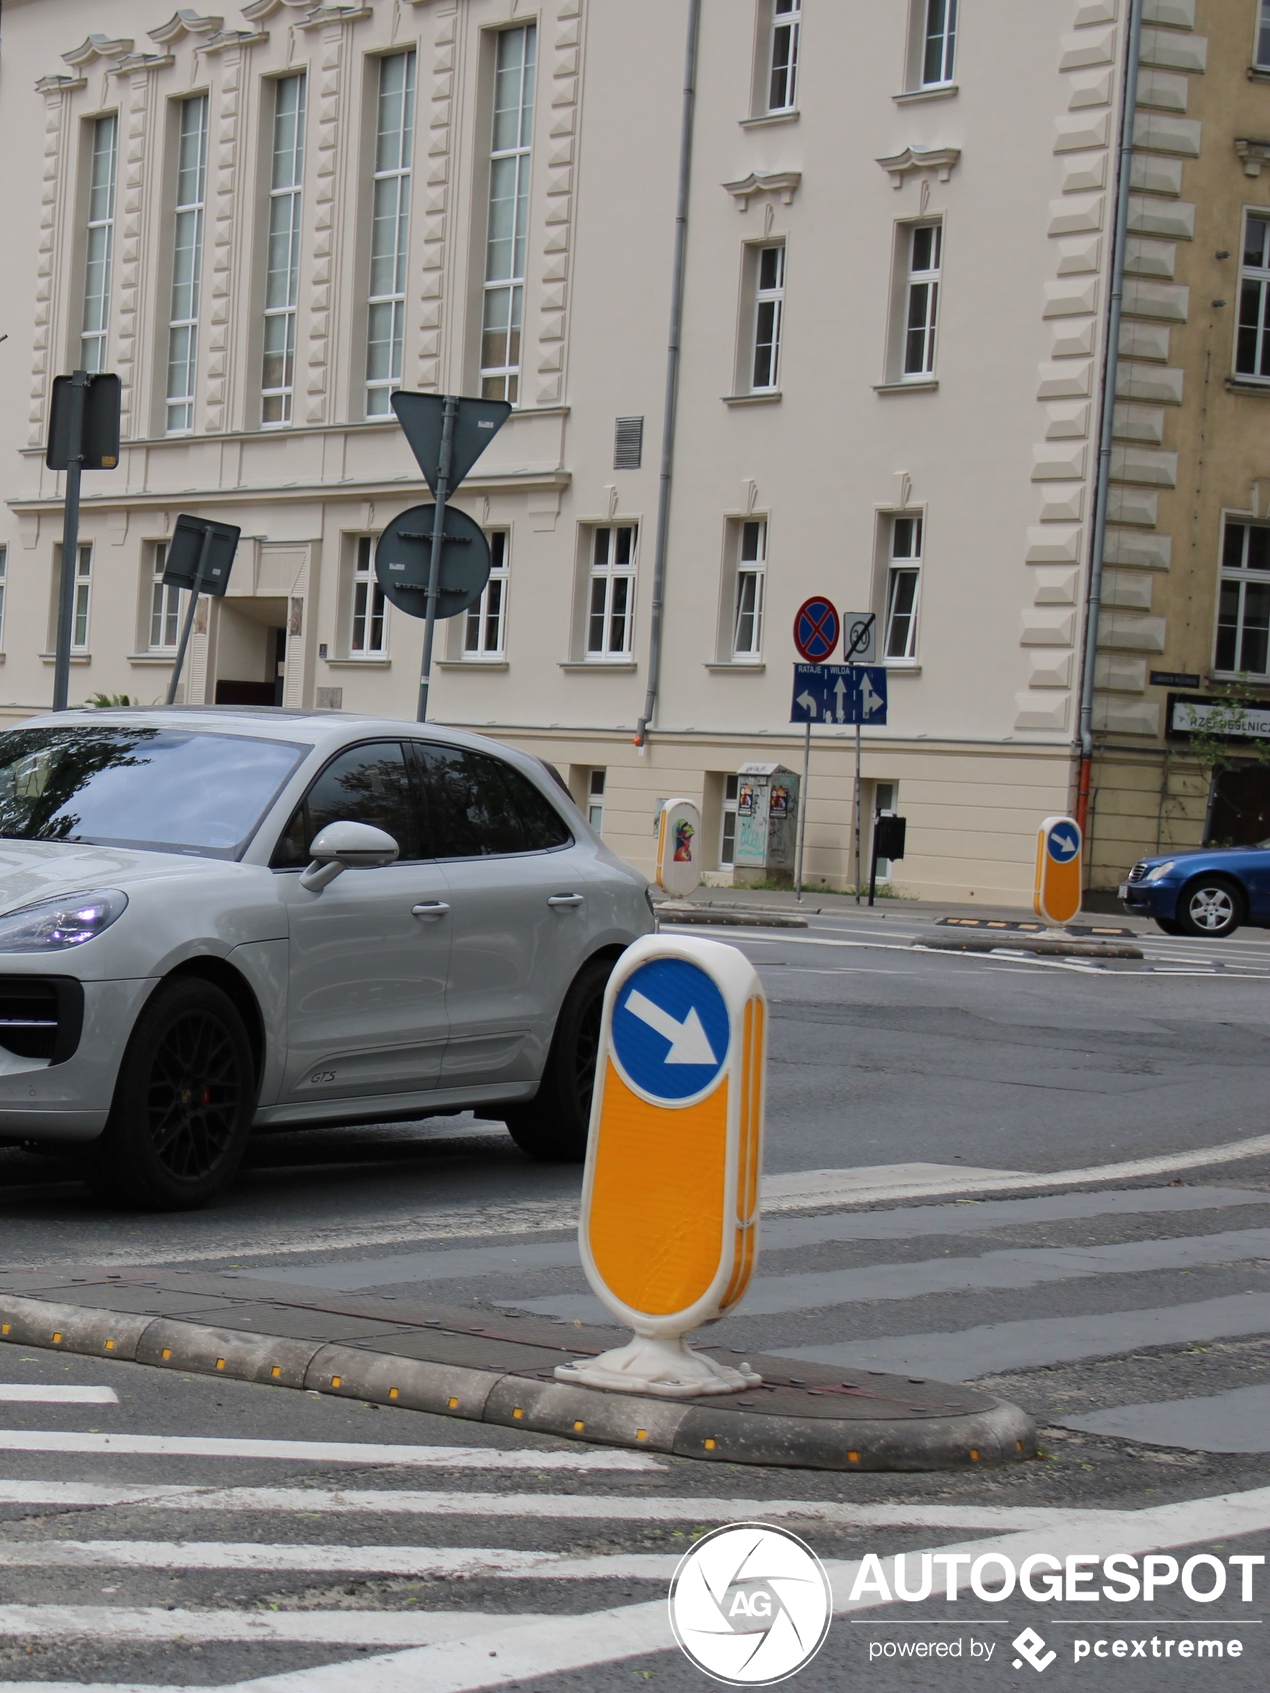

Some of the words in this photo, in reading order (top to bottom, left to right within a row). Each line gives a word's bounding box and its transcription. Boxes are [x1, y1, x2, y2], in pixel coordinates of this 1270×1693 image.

[797, 665, 822, 674] RATAJE
[830, 666, 850, 675] WILDA
[310, 1071, 336, 1083] GTS
